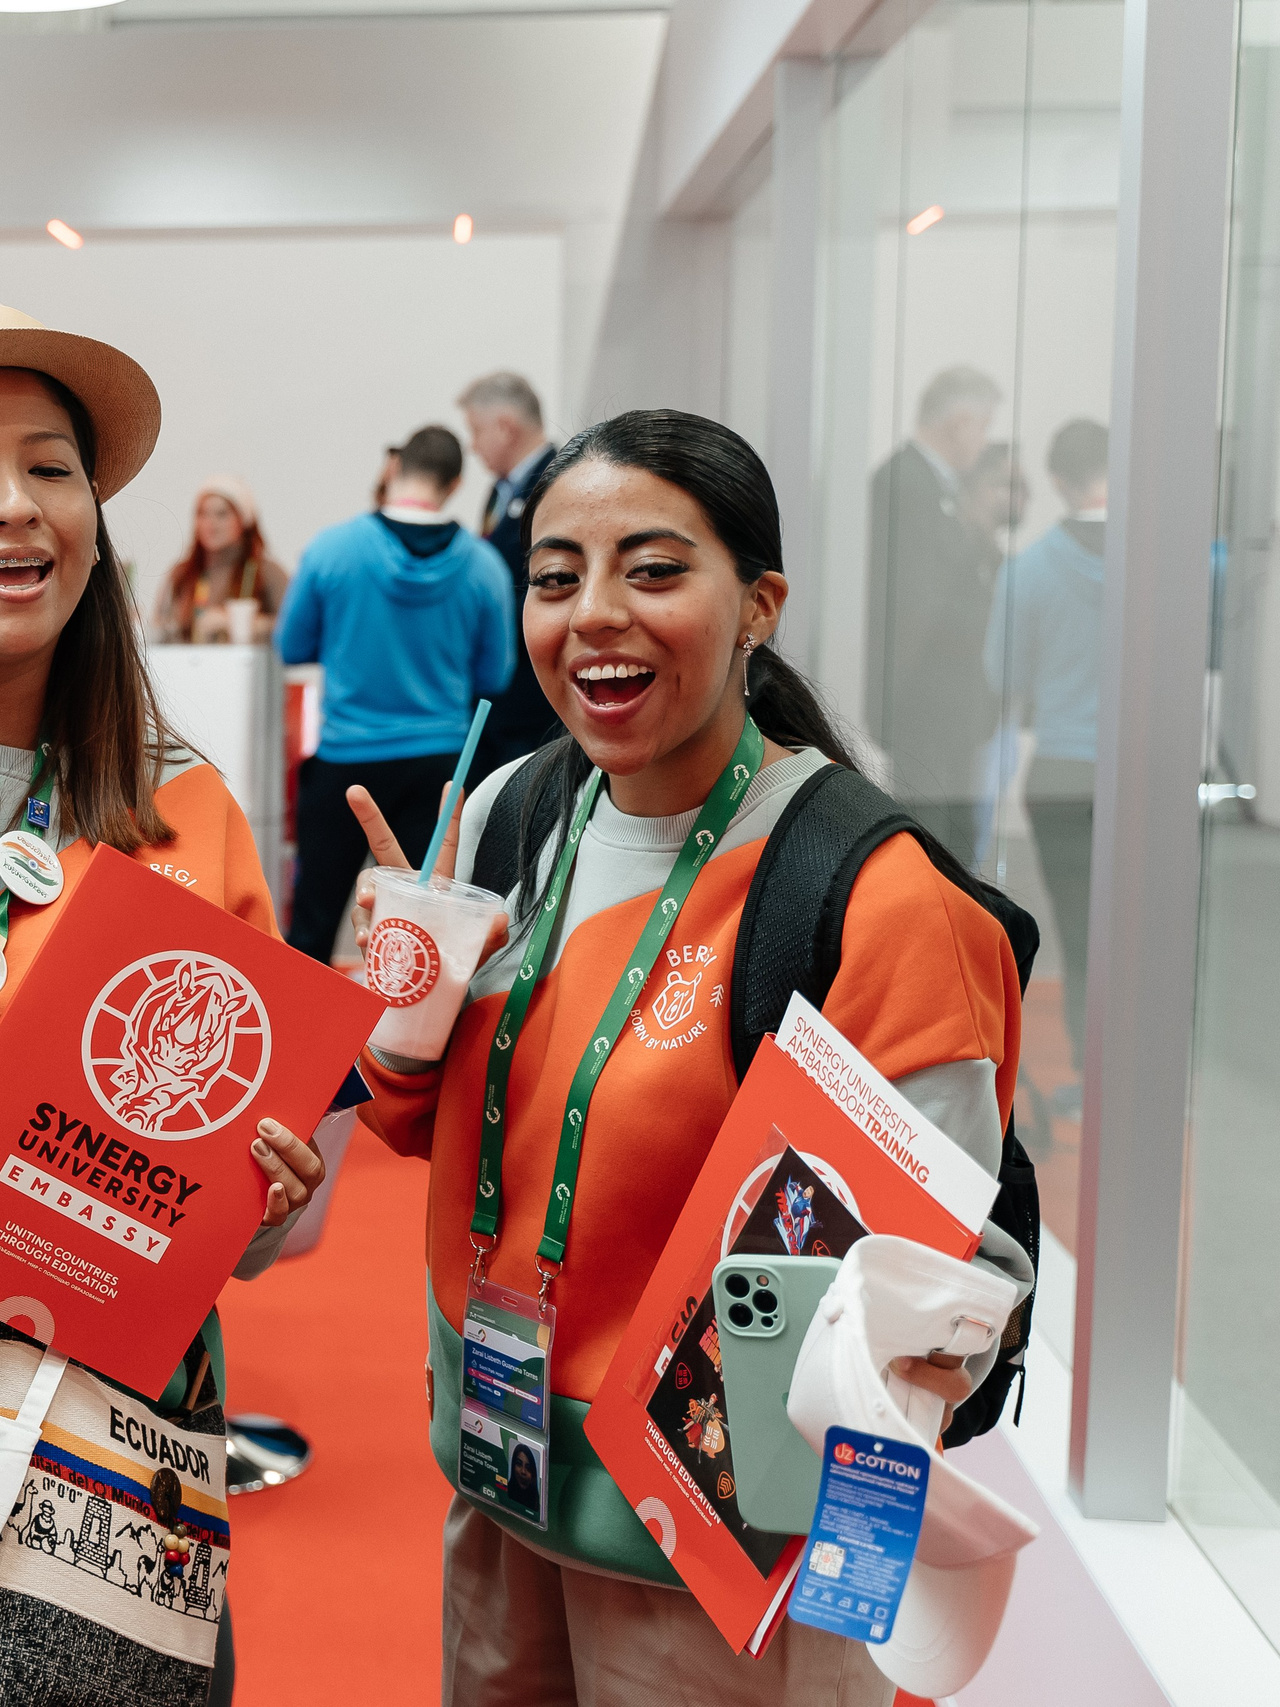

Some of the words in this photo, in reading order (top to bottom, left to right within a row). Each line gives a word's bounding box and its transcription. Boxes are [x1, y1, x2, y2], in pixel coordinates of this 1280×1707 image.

[630, 1009, 649, 1042] BORN
[645, 1037, 660, 1050] BY
[660, 1020, 708, 1050] NATURE
[786, 1035, 865, 1121] AMBASSADOR
[864, 1112, 930, 1184] TRAINING
[794, 1016, 849, 1073] SYNERGY
[847, 1069, 918, 1144] UNIVERSITY
[18, 1130, 186, 1228] UNIVERSITY
[28, 1102, 203, 1206] SYNERGY
[7, 1165, 160, 1253] EMBASSY
[5, 1220, 54, 1252] UNITING
[54, 1246, 119, 1286] COUNTRIES
[27, 1261, 39, 1270] МИР
[43, 1269, 70, 1287] ПОМОЩЬЮ
[71, 1284, 105, 1304] ОБРАЗОВАНИЯ
[51, 1258, 119, 1299] EDUCATION
[523, 1369, 539, 1381] Torres
[110, 1405, 210, 1485] ECUADOR
[644, 1420, 680, 1470] THROUGH
[677, 1464, 722, 1525] EDUCATION
[855, 1452, 920, 1479] COTTON
[69, 1469, 89, 1489] del
[482, 1486, 496, 1499] ECU
